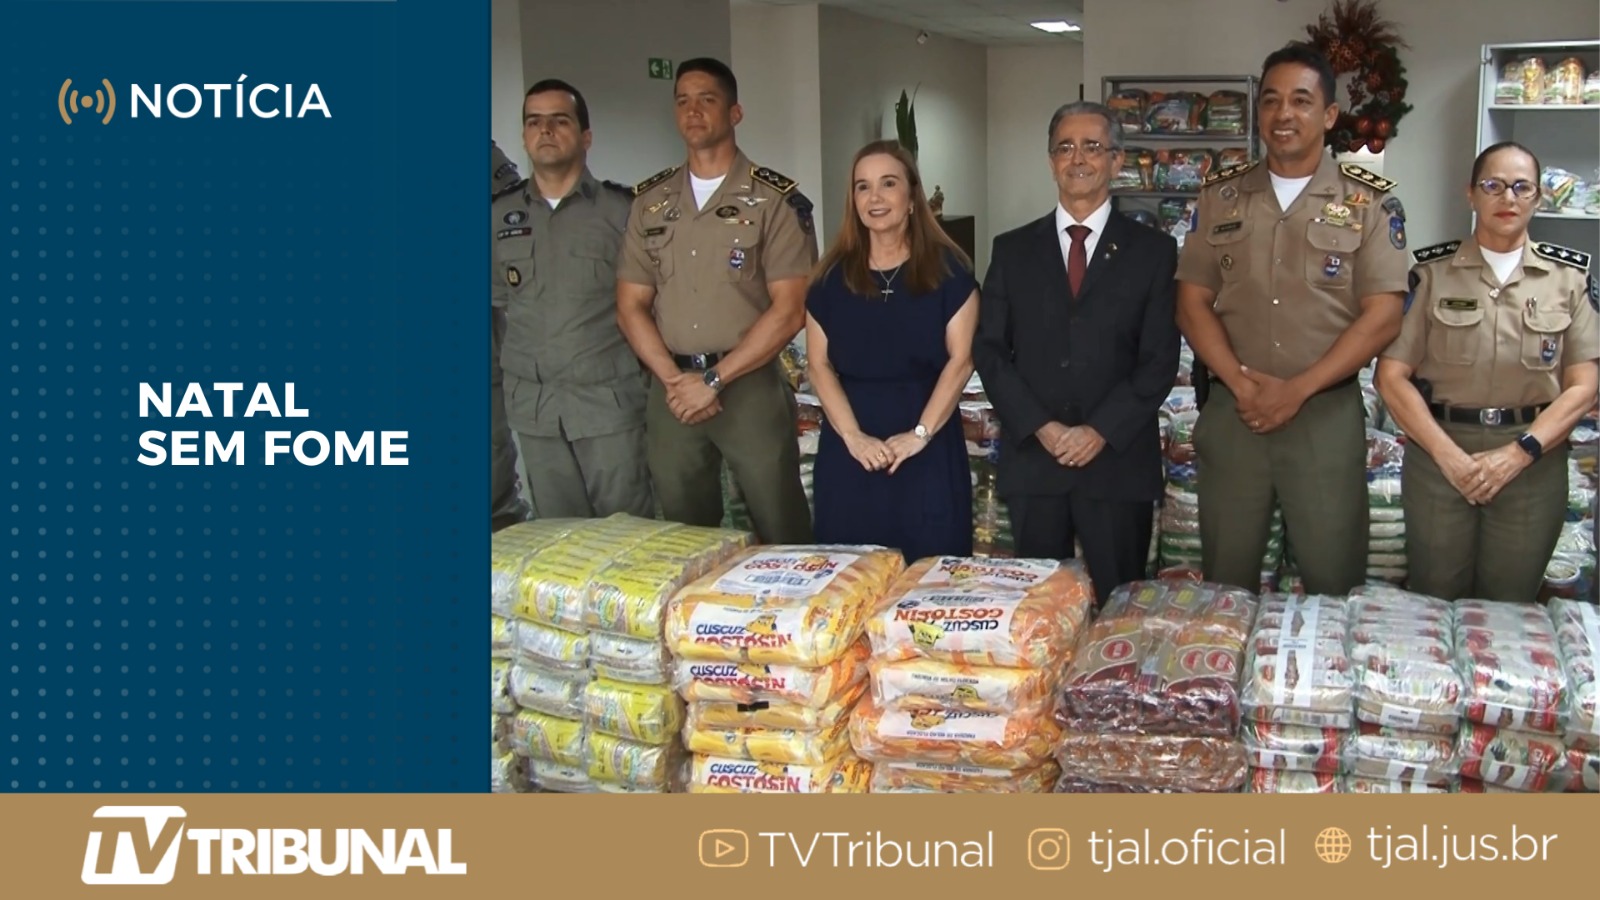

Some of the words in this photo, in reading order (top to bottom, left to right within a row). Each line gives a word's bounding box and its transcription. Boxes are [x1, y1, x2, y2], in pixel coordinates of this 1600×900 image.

[696, 623, 745, 635] CUSCUZ
[942, 619, 999, 632] CUSCUZ
[689, 665, 738, 677] CUSCUZ
[710, 763, 757, 775] CUSCUZ
